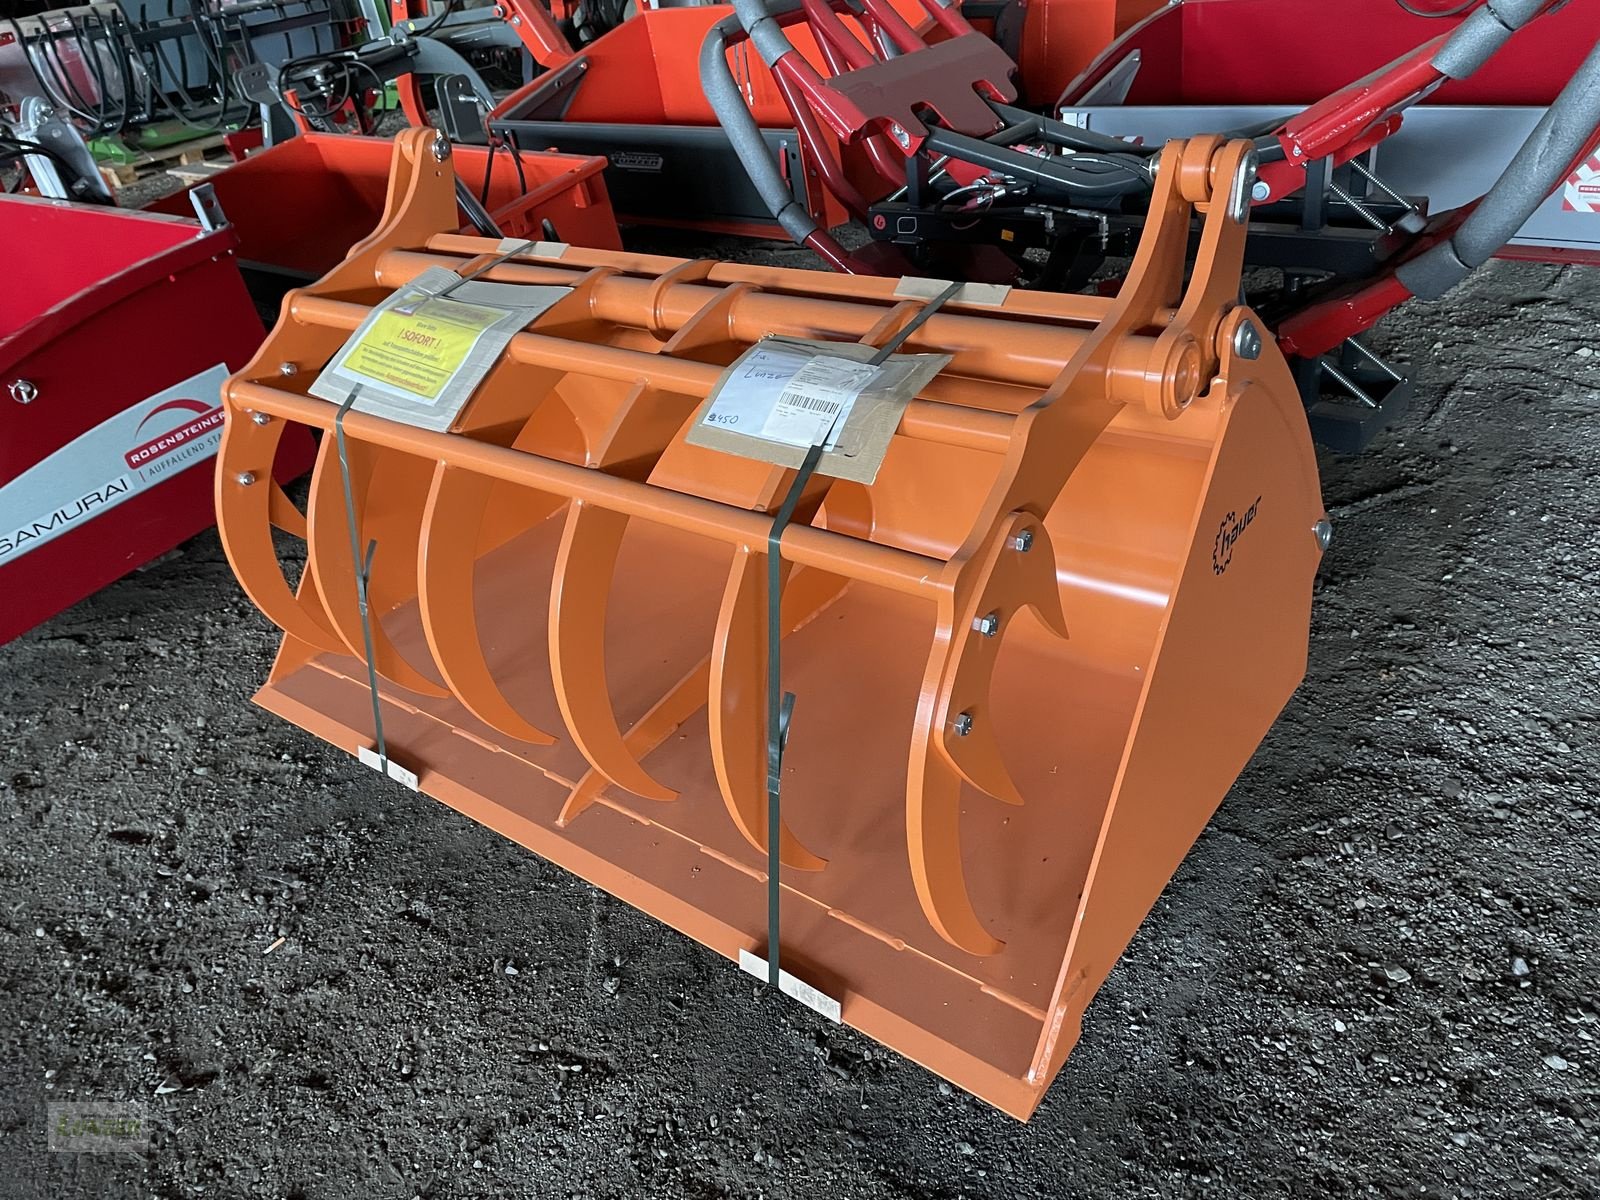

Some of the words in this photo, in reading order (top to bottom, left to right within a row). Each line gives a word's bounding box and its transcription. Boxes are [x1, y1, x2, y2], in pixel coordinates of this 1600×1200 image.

[403, 331, 436, 347] SOFORT
[130, 411, 225, 464] ROSENSTEINER
[149, 442, 205, 477] AUFFALLEND
[0, 478, 128, 555] SAMURAI
[1221, 495, 1262, 556] hauer
